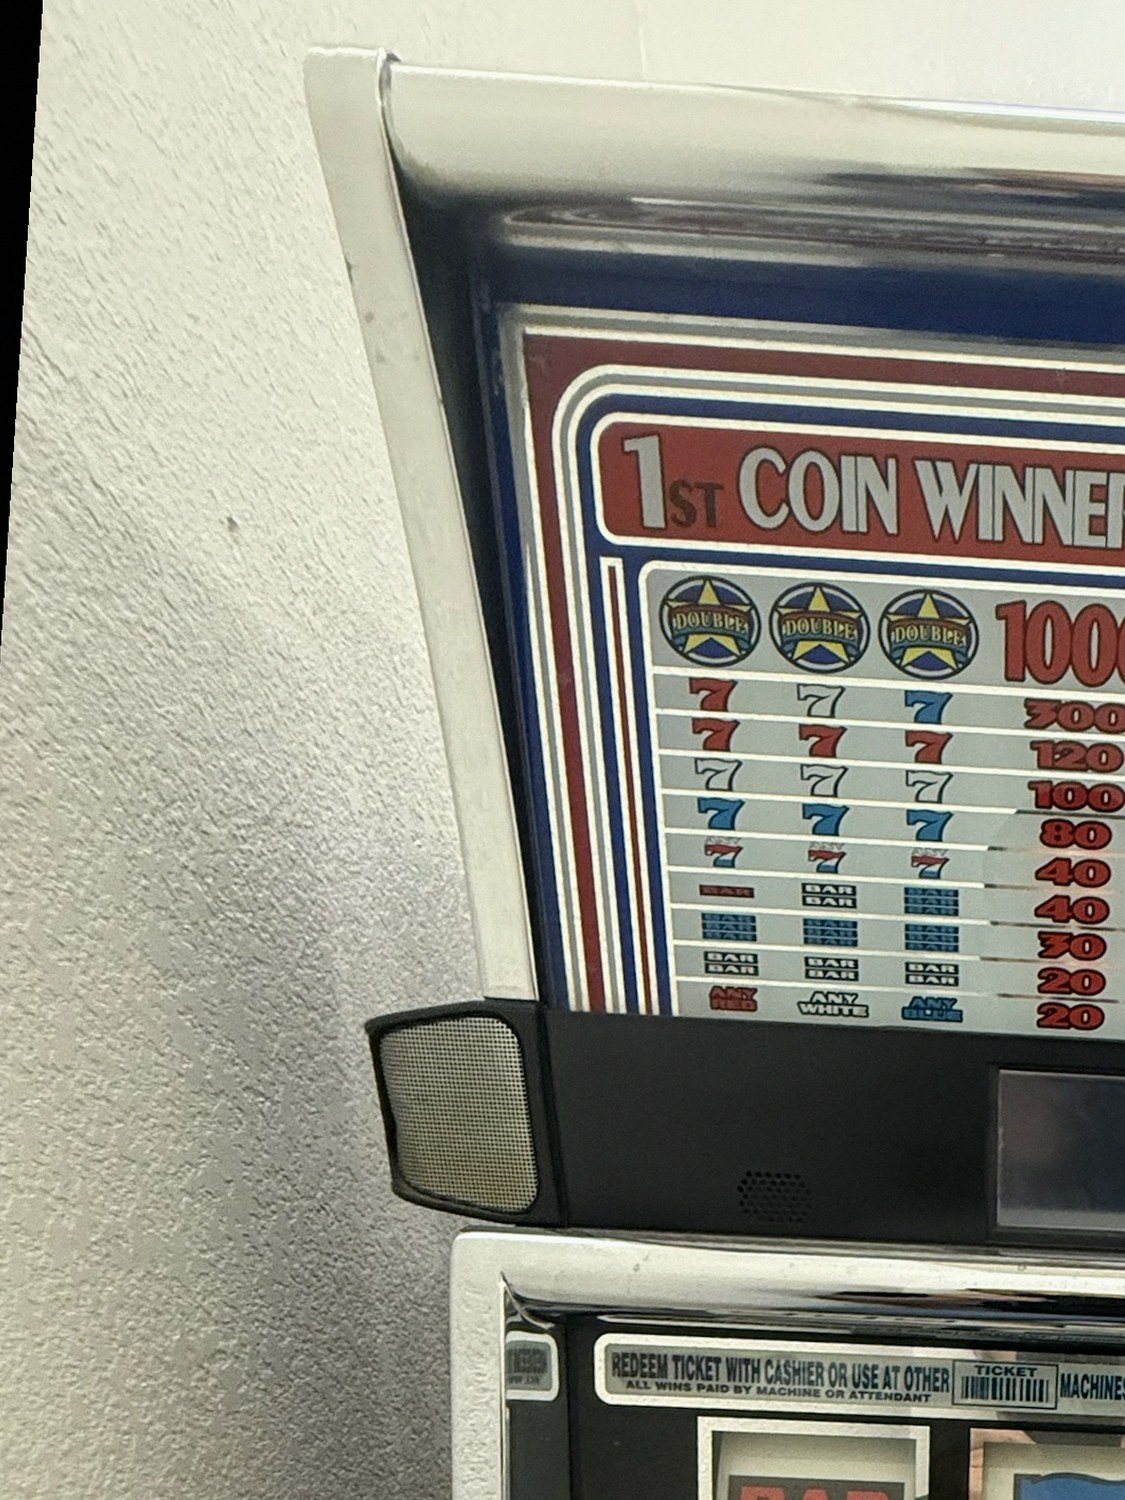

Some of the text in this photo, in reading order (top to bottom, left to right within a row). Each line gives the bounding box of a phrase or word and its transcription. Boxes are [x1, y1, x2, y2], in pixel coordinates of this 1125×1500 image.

[623, 434, 722, 529] 1ST
[738, 447, 898, 535] COIN
[676, 610, 748, 633] DOUBLE
[785, 616, 857, 639] DOUBLE
[894, 624, 967, 647] DOUBLE
[689, 678, 738, 712] 7
[798, 684, 845, 718] 7
[905, 690, 952, 723] 7
[1030, 740, 1124, 772] 120
[1028, 781, 1125, 812] 100
[1040, 819, 1112, 849] 80
[1035, 858, 1110, 888] 40
[805, 883, 853, 895] BAR
[805, 896, 854, 907] BAR
[1034, 895, 1109, 924] 40
[1038, 931, 1106, 960] 30
[1038, 967, 1106, 995] 20
[798, 1001, 868, 1018] WHITE
[810, 991, 858, 1004] ANY
[1037, 1002, 1104, 1030] 20
[611, 1352, 668, 1380] REDEEM
[672, 1355, 721, 1381] TICKET
[726, 1358, 760, 1383] WITH
[765, 1359, 823, 1387] CASHIER
[829, 1362, 847, 1388] OR
[853, 1363, 878, 1389] USE
[883, 1366, 900, 1390] AT
[904, 1366, 949, 1392] OTHER
[975, 1365, 1038, 1377] TICKET
[626, 1380, 931, 1403] ALL WINS PAID BY MACHINE OR ATTENDANT
